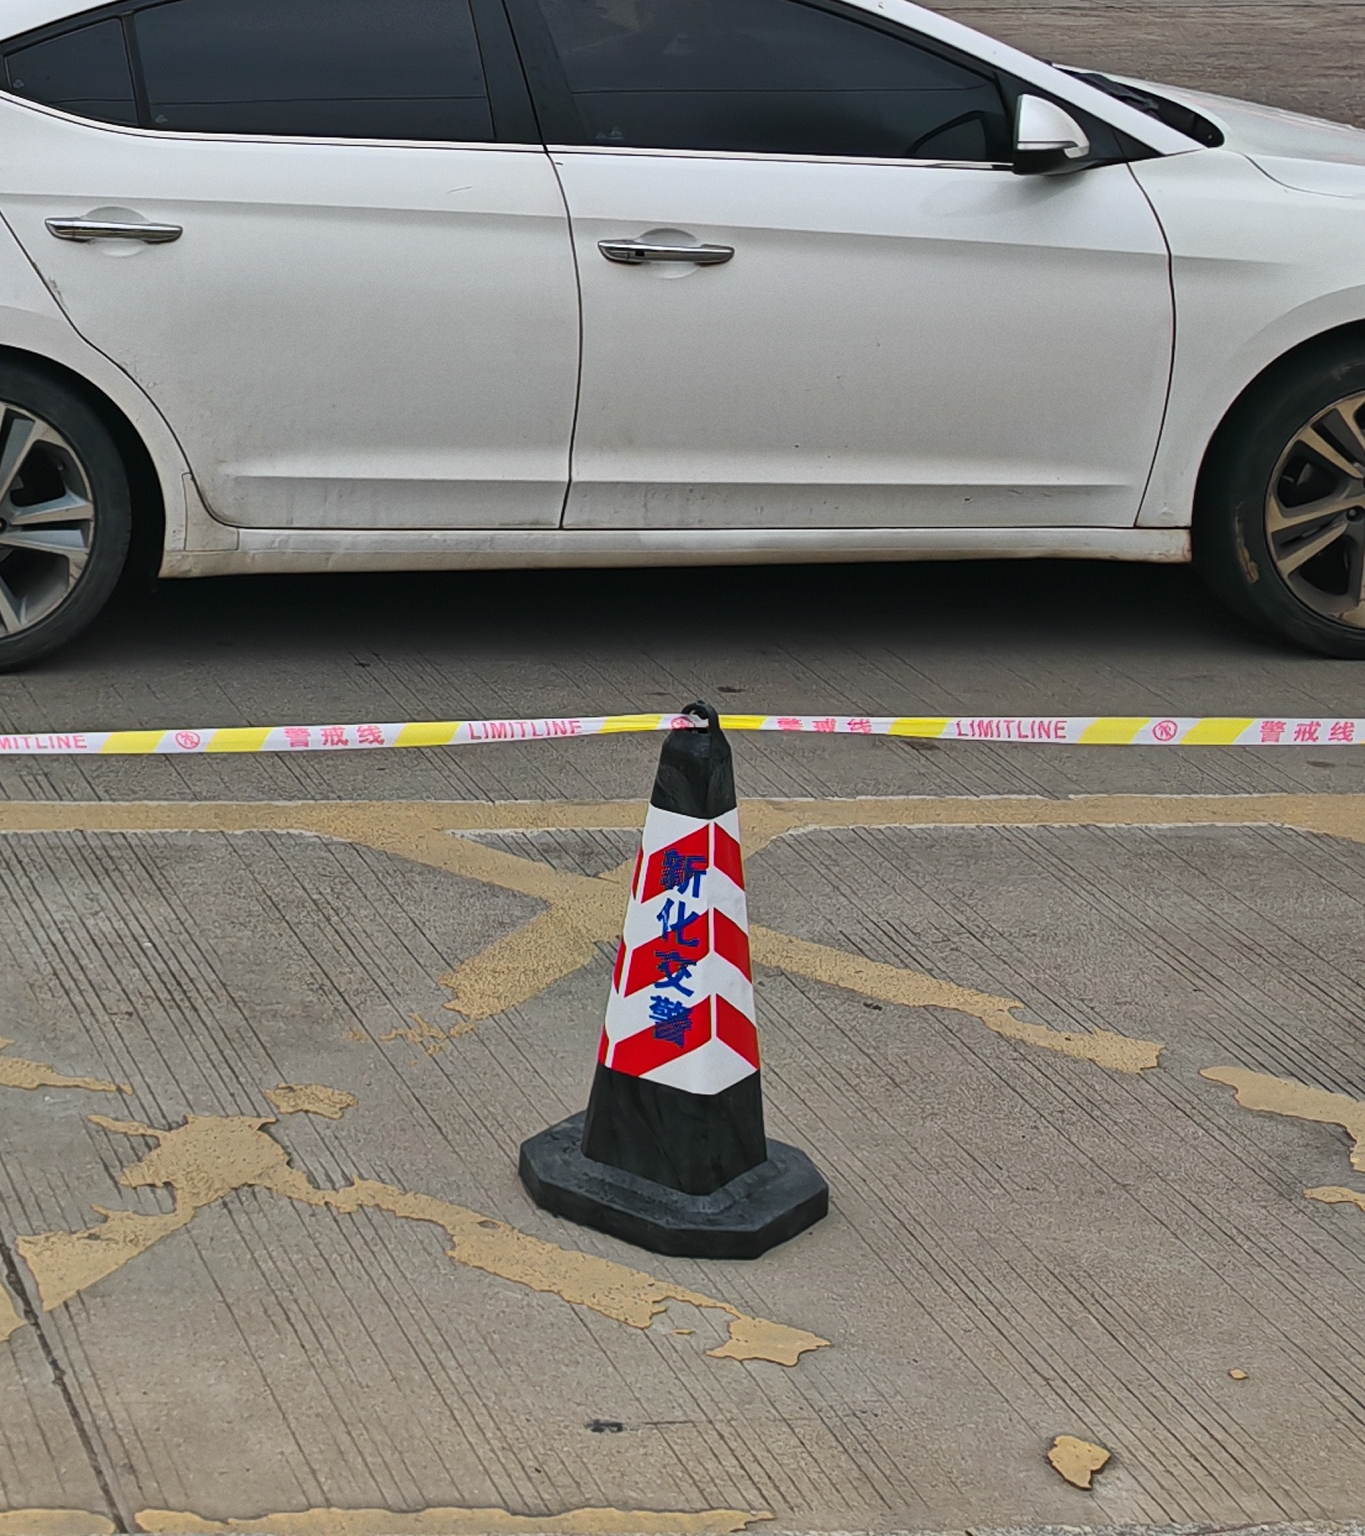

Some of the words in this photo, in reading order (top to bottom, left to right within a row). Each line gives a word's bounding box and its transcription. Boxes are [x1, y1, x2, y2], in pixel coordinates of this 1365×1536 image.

[283, 725, 386, 748] 警戒线
[955, 719, 1068, 741] LIMITLINE
[1260, 721, 1356, 743] 警戒线
[648, 848, 709, 1048] 新化交警
